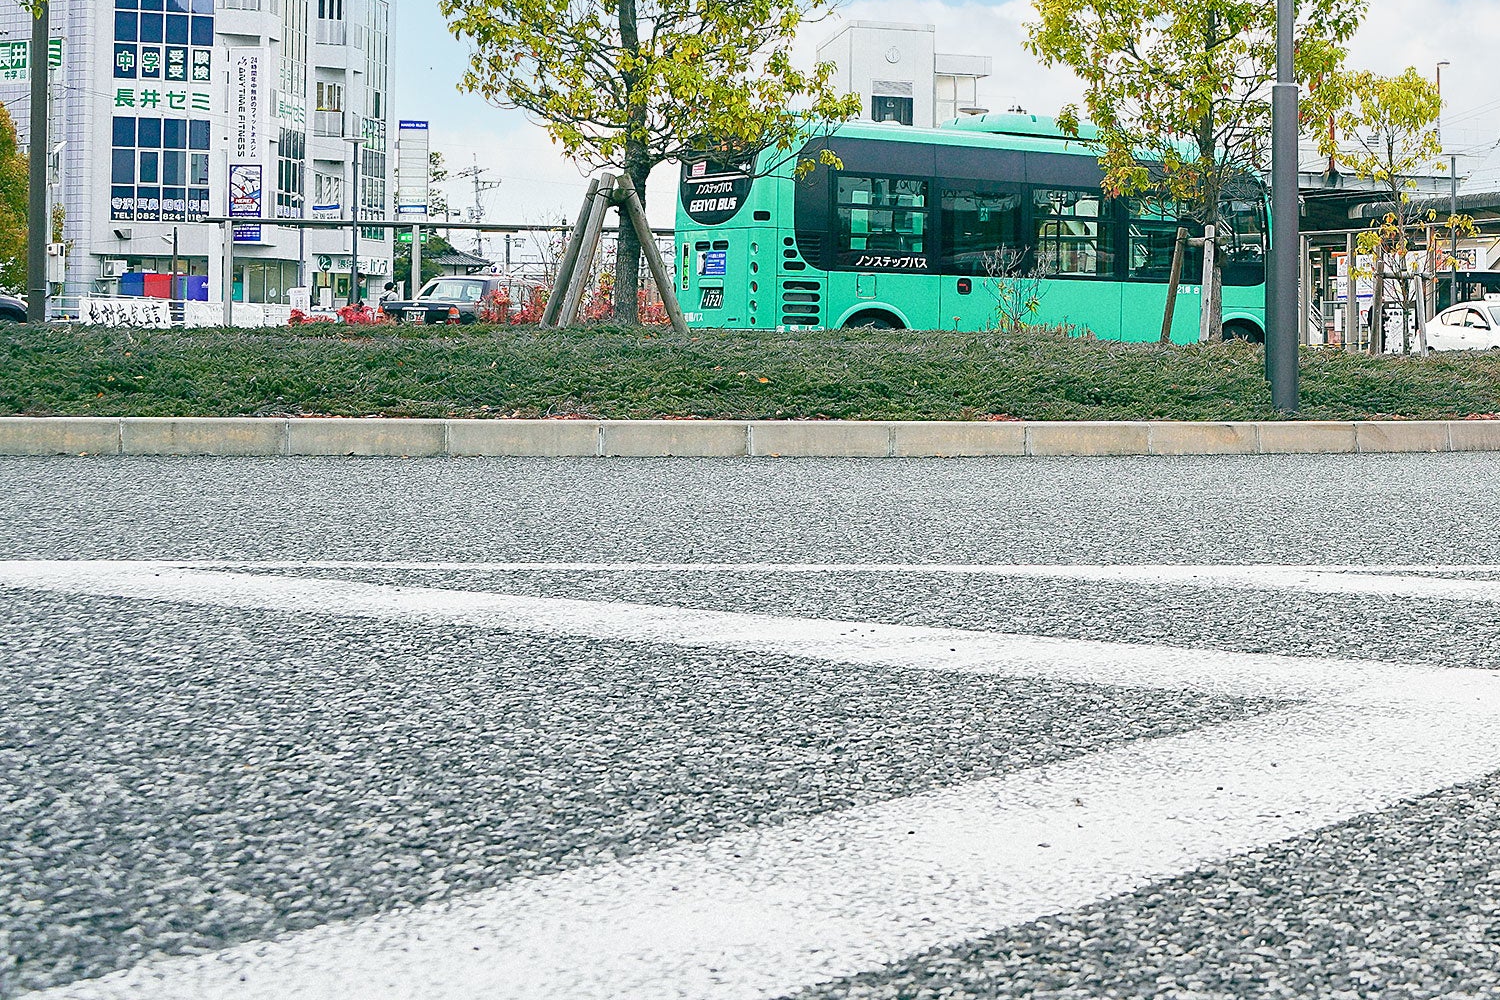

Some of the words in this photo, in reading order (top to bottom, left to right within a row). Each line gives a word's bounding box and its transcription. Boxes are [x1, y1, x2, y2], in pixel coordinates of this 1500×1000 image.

[114, 88, 210, 111] 長井ゼミ
[237, 114, 246, 158] FITNESS
[695, 182, 733, 195] ノンステップバス
[690, 199, 717, 213] GEIYO
[717, 197, 738, 211] BUS
[855, 255, 928, 268] ノンステップバス
